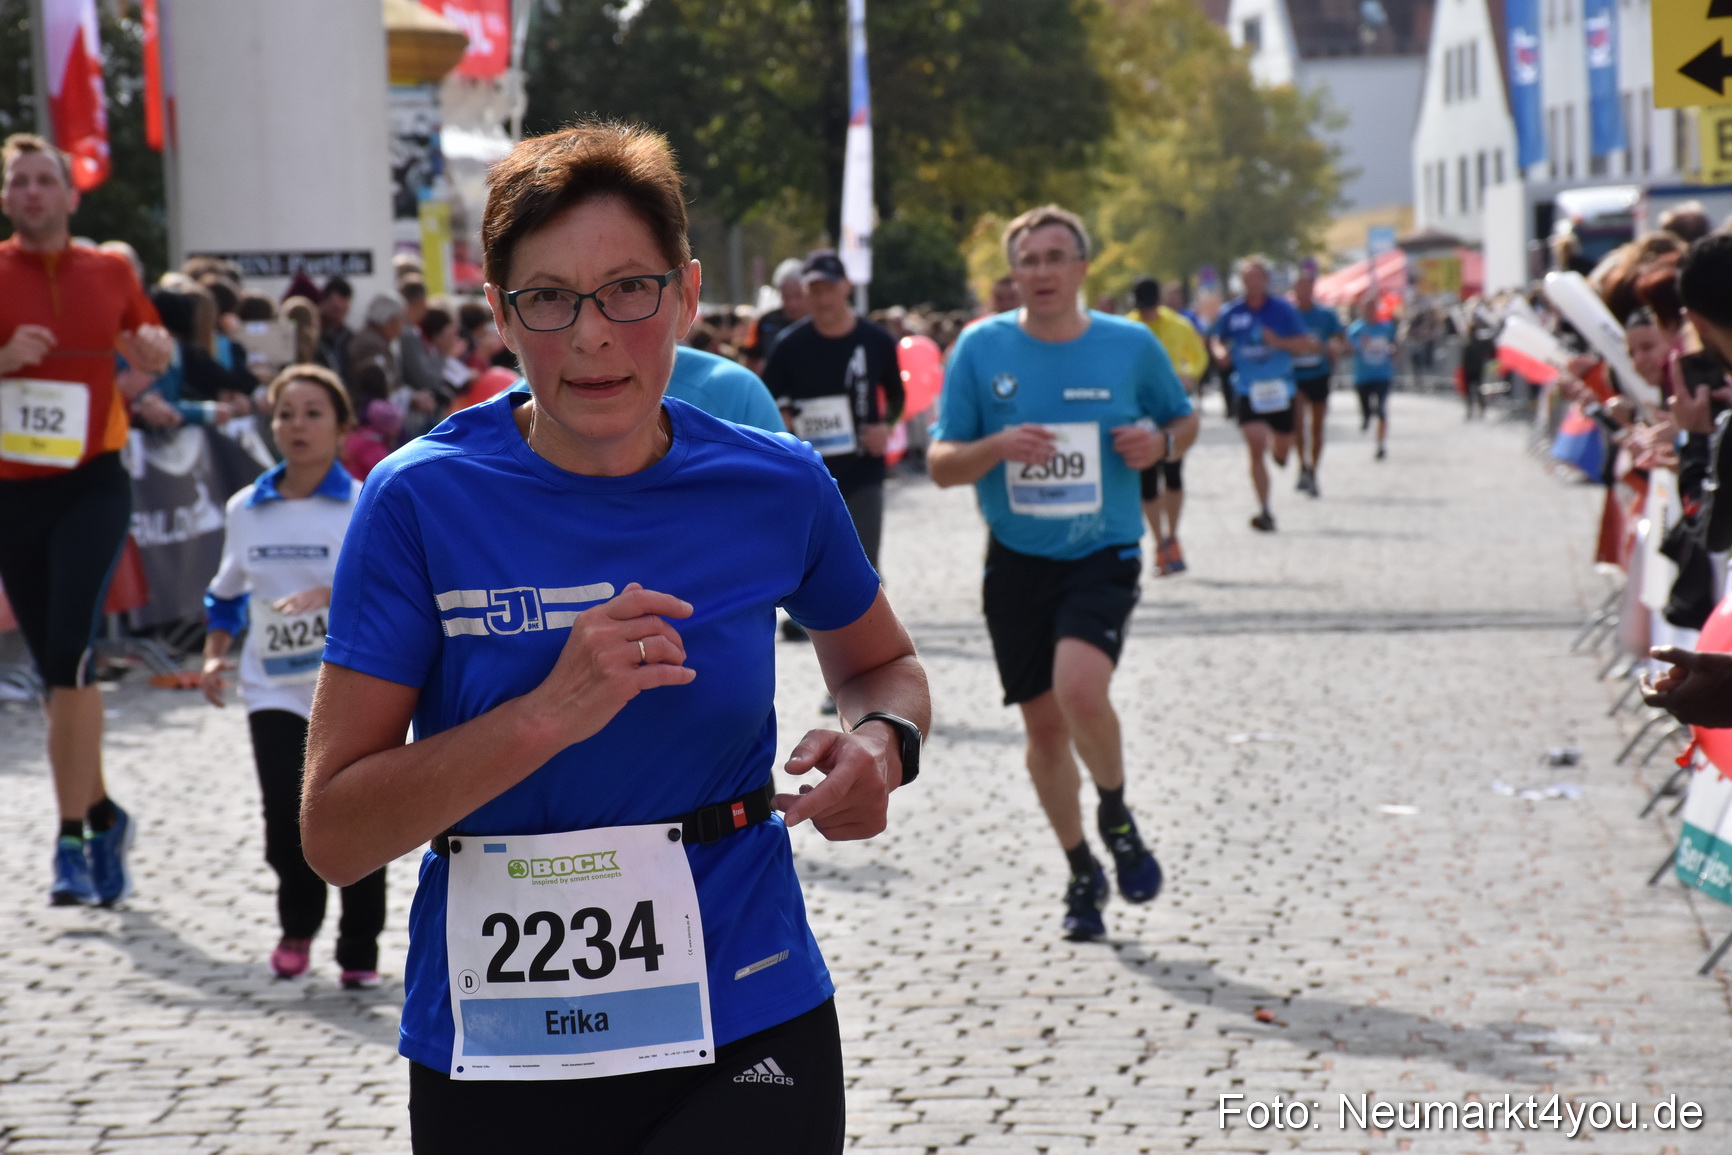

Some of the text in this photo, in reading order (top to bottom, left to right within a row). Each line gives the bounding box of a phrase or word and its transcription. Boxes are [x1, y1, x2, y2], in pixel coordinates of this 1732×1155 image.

[21, 406, 65, 434] 152
[266, 615, 328, 651] 2424
[530, 851, 620, 878] BOCK
[532, 871, 622, 886] inspired by smart concepts
[482, 900, 664, 983] 2234
[465, 976, 473, 988] D
[545, 1009, 609, 1035] Erika
[733, 1073, 794, 1086] adidas
